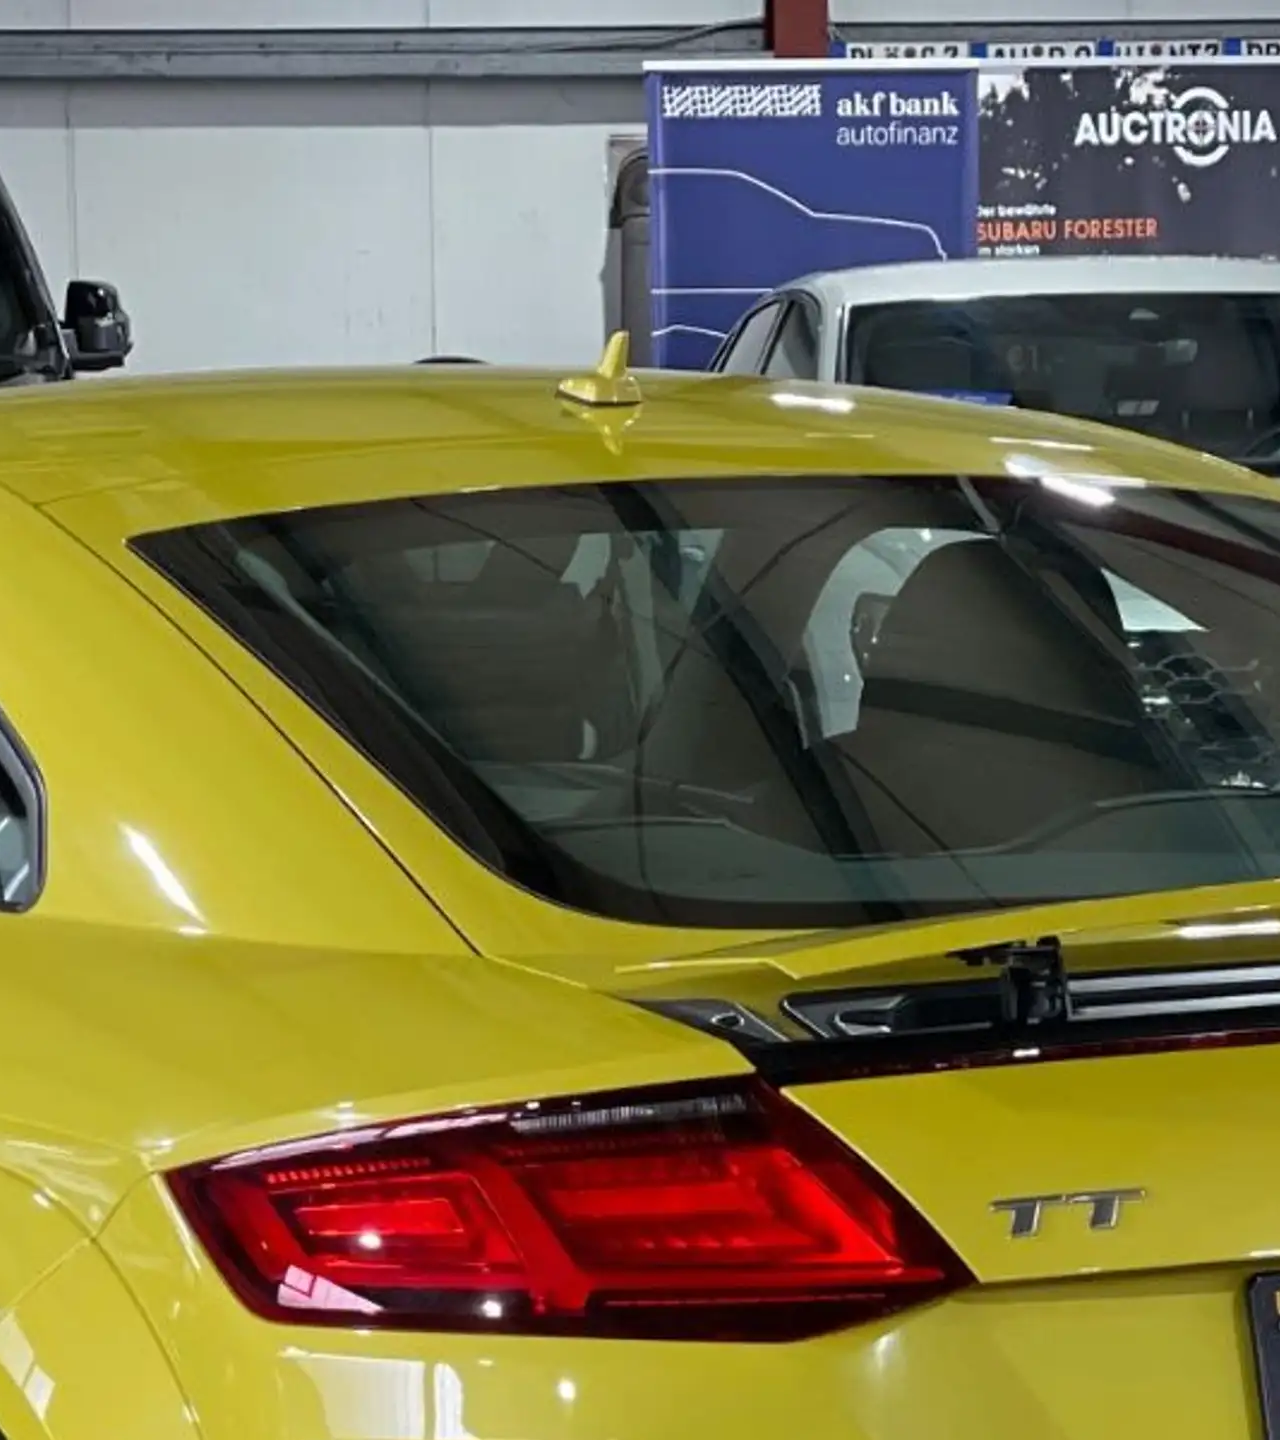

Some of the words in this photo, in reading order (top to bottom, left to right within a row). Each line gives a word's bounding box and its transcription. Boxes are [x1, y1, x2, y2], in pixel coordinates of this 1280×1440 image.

[836, 91, 888, 118] akf
[889, 90, 961, 118] bank
[836, 121, 960, 147] autofinanz
[1073, 107, 1278, 147] AUCTRONIA
[977, 219, 1057, 242] SUBARU
[1063, 217, 1158, 240] FORESTER
[988, 1186, 1147, 1240] TT
